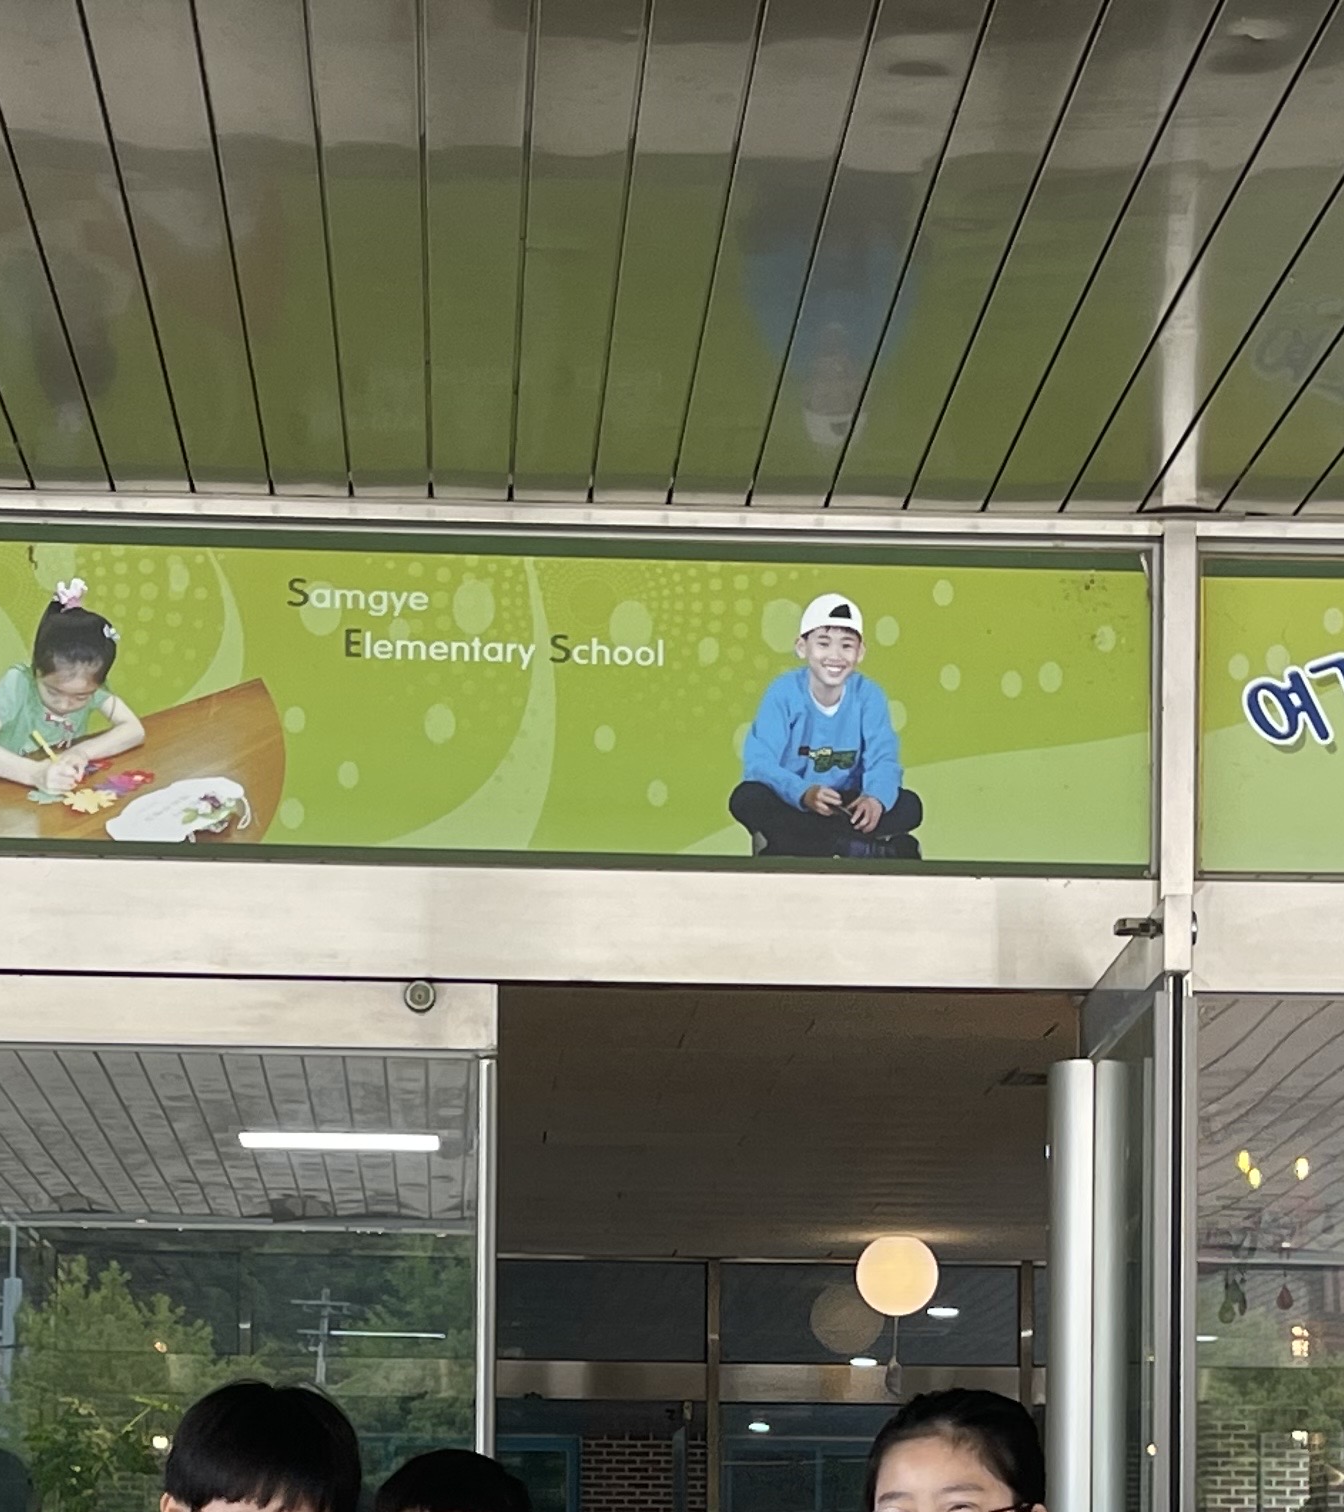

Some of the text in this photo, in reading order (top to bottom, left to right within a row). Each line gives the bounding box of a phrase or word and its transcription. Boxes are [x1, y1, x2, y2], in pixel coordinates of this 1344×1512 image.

[287, 578, 429, 617] Samgye
[345, 629, 665, 669] Elementary School
